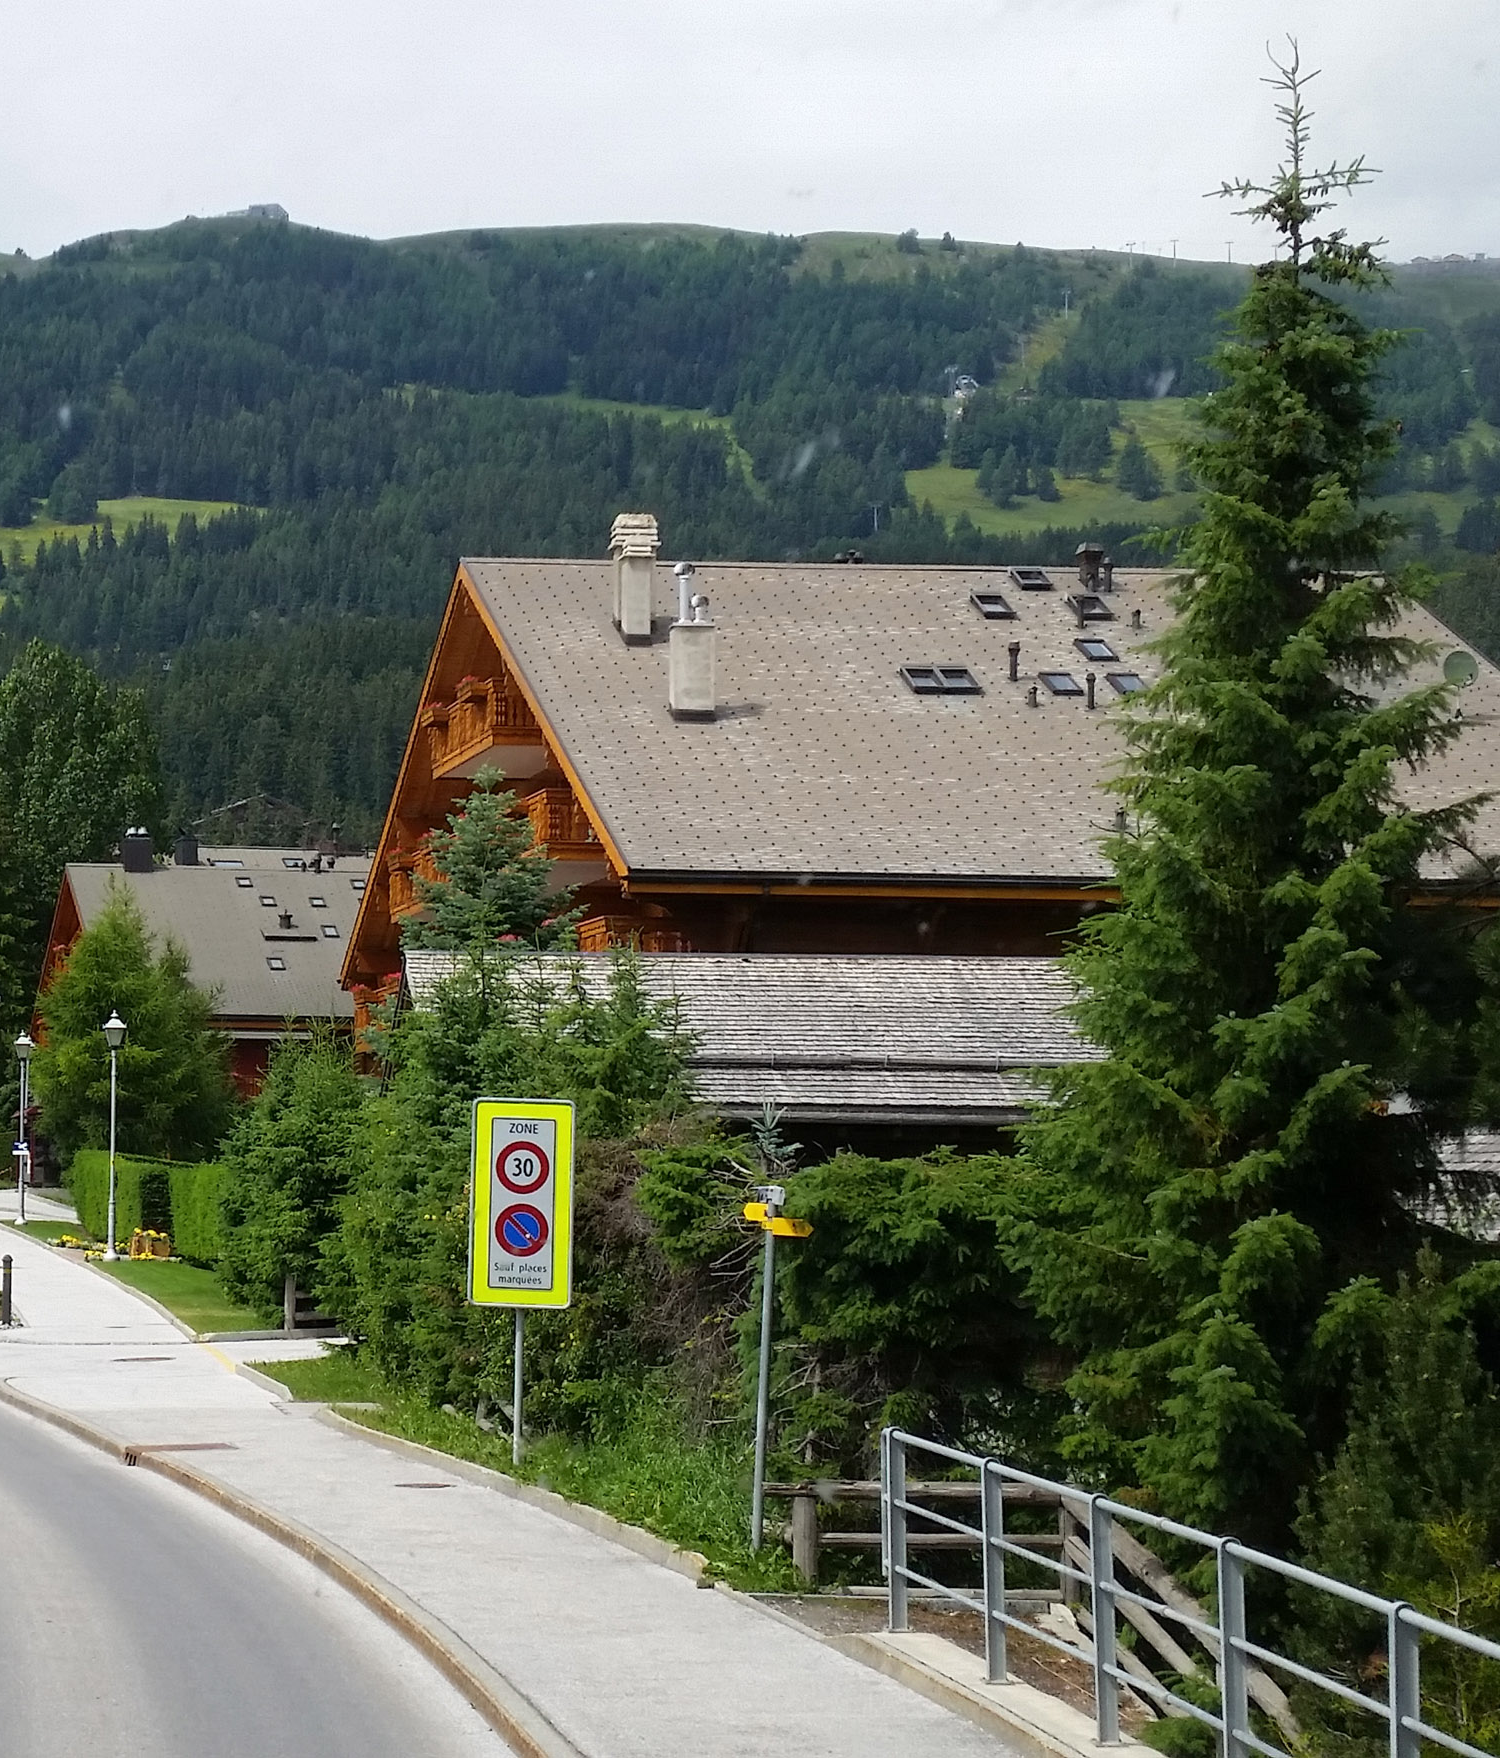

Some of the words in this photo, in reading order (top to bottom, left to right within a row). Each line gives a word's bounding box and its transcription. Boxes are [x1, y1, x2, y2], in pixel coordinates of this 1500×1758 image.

[509, 1122, 539, 1135] ZONE
[512, 1157, 534, 1177] 30
[519, 1263, 547, 1274] places
[498, 1274, 542, 1287] marquées
